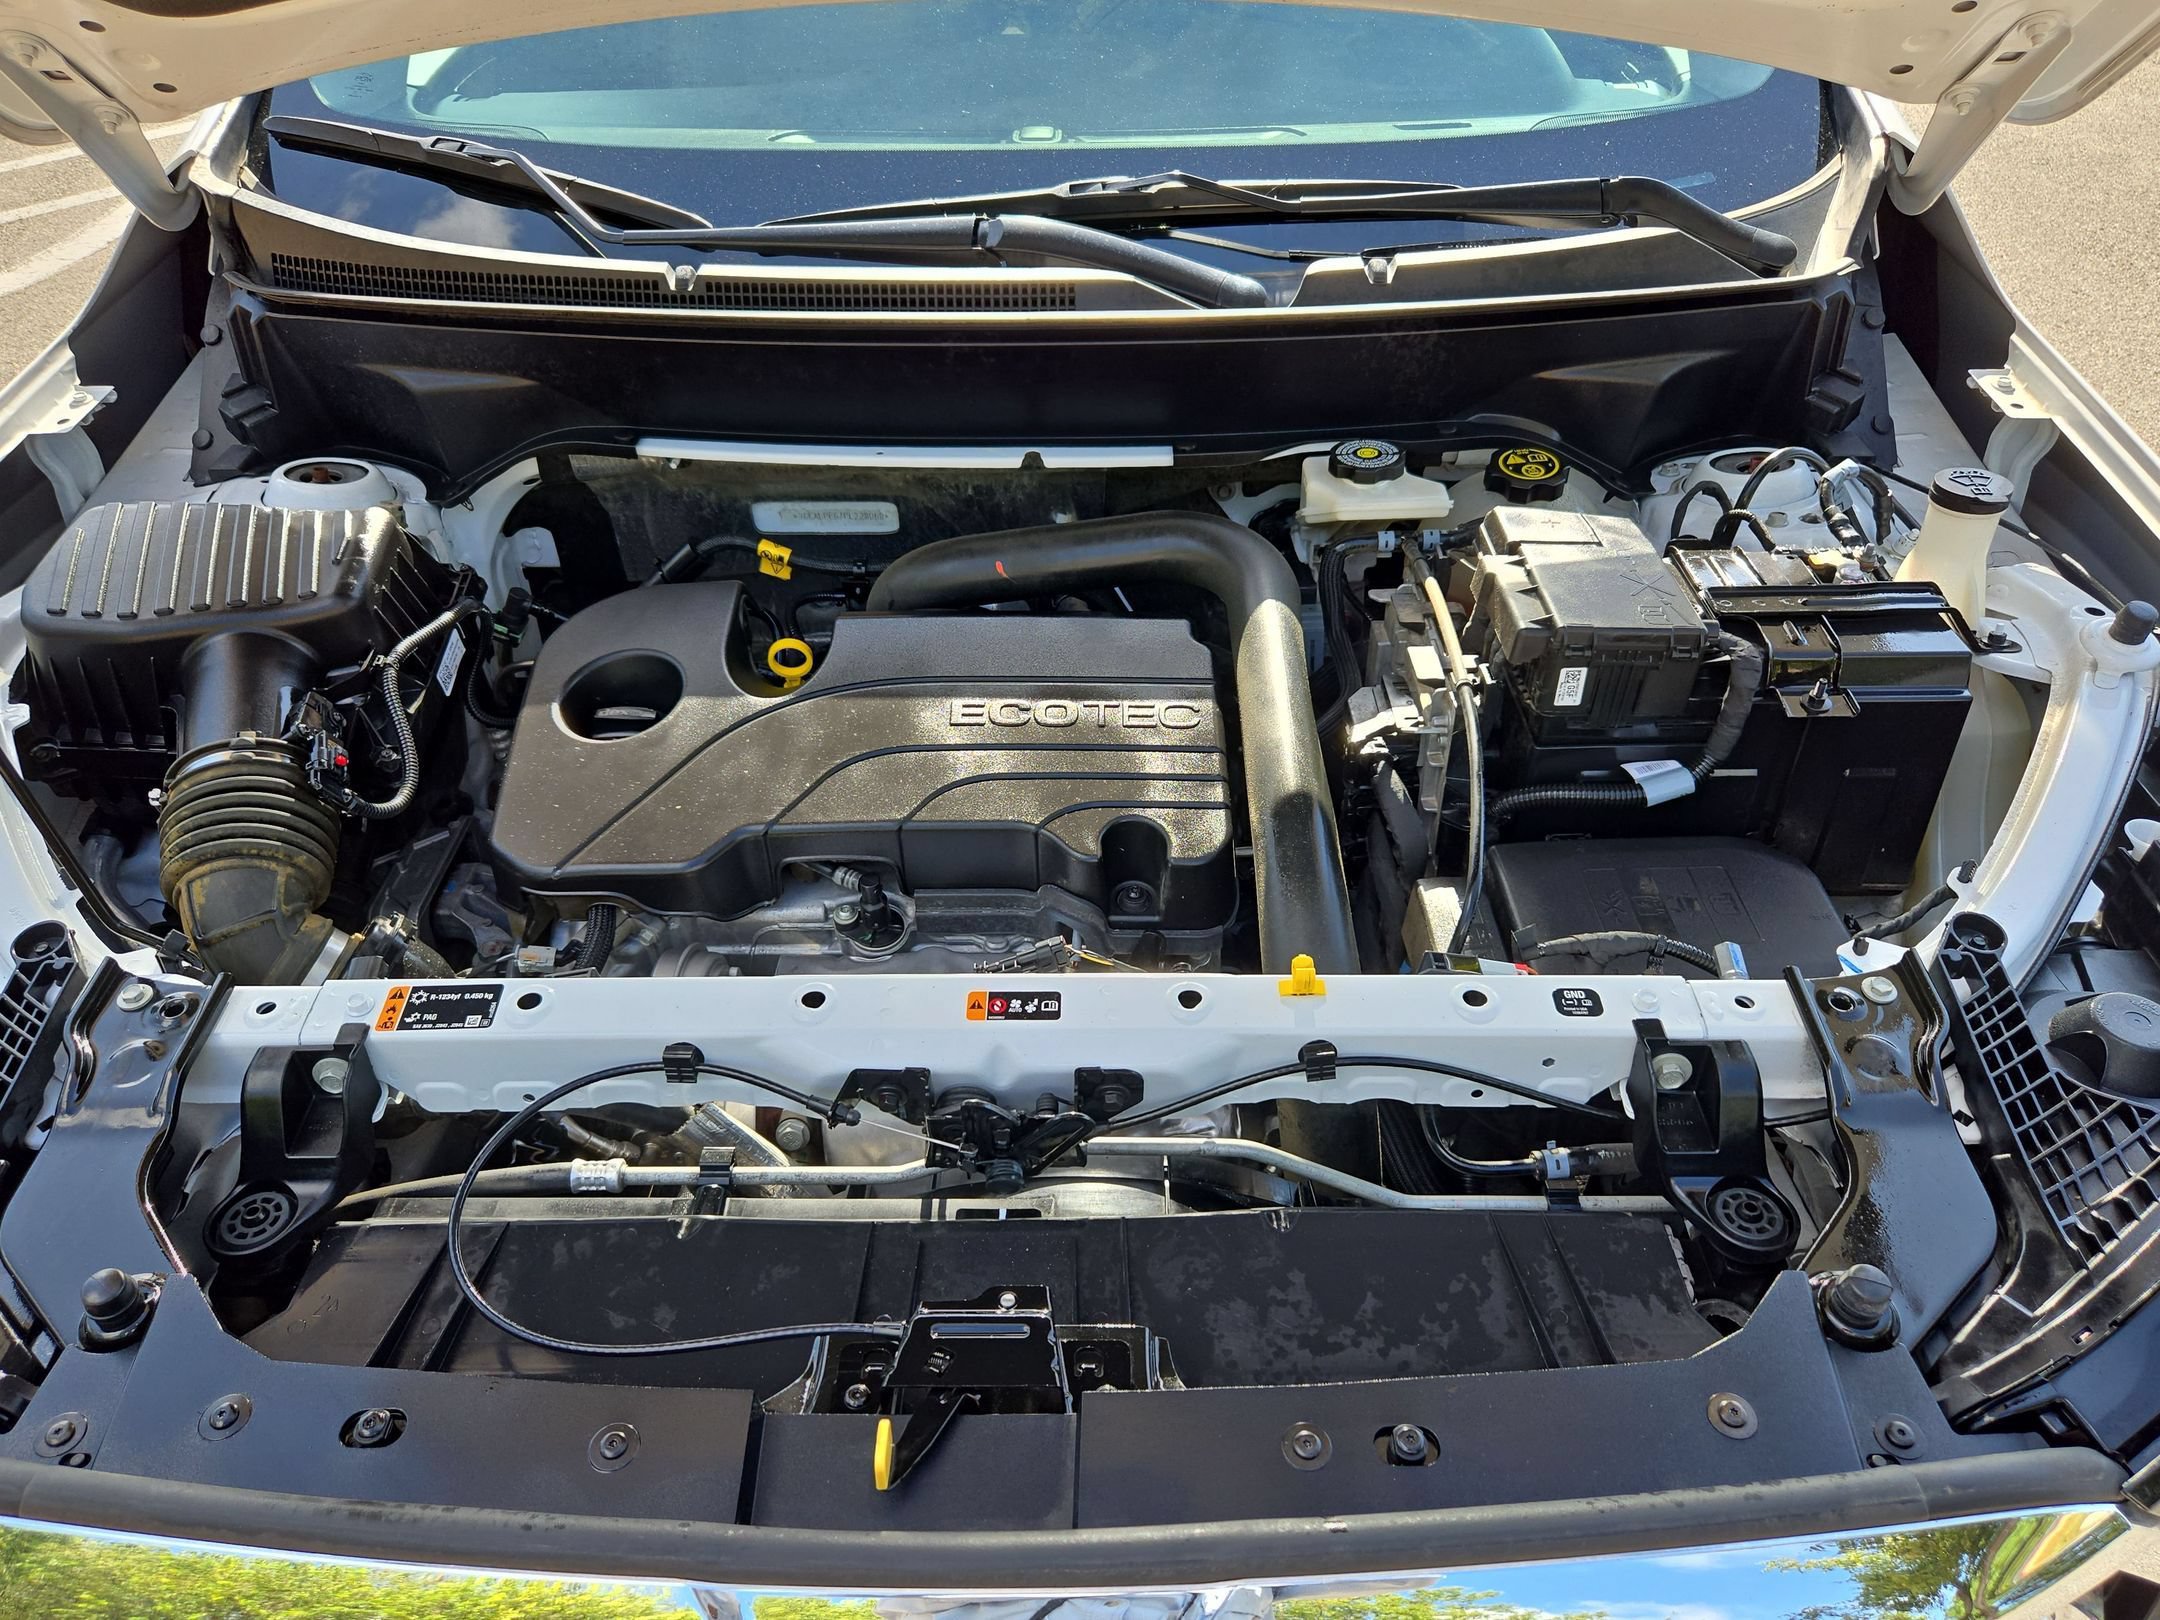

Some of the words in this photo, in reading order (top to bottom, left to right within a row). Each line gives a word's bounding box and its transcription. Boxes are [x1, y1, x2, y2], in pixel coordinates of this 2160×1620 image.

[949, 699, 1201, 729] ECOTEC
[430, 993, 461, 1001] R-1234yf
[484, 992, 494, 1000] kg
[1563, 990, 1586, 999] GND
[422, 1013, 438, 1021] PAG
